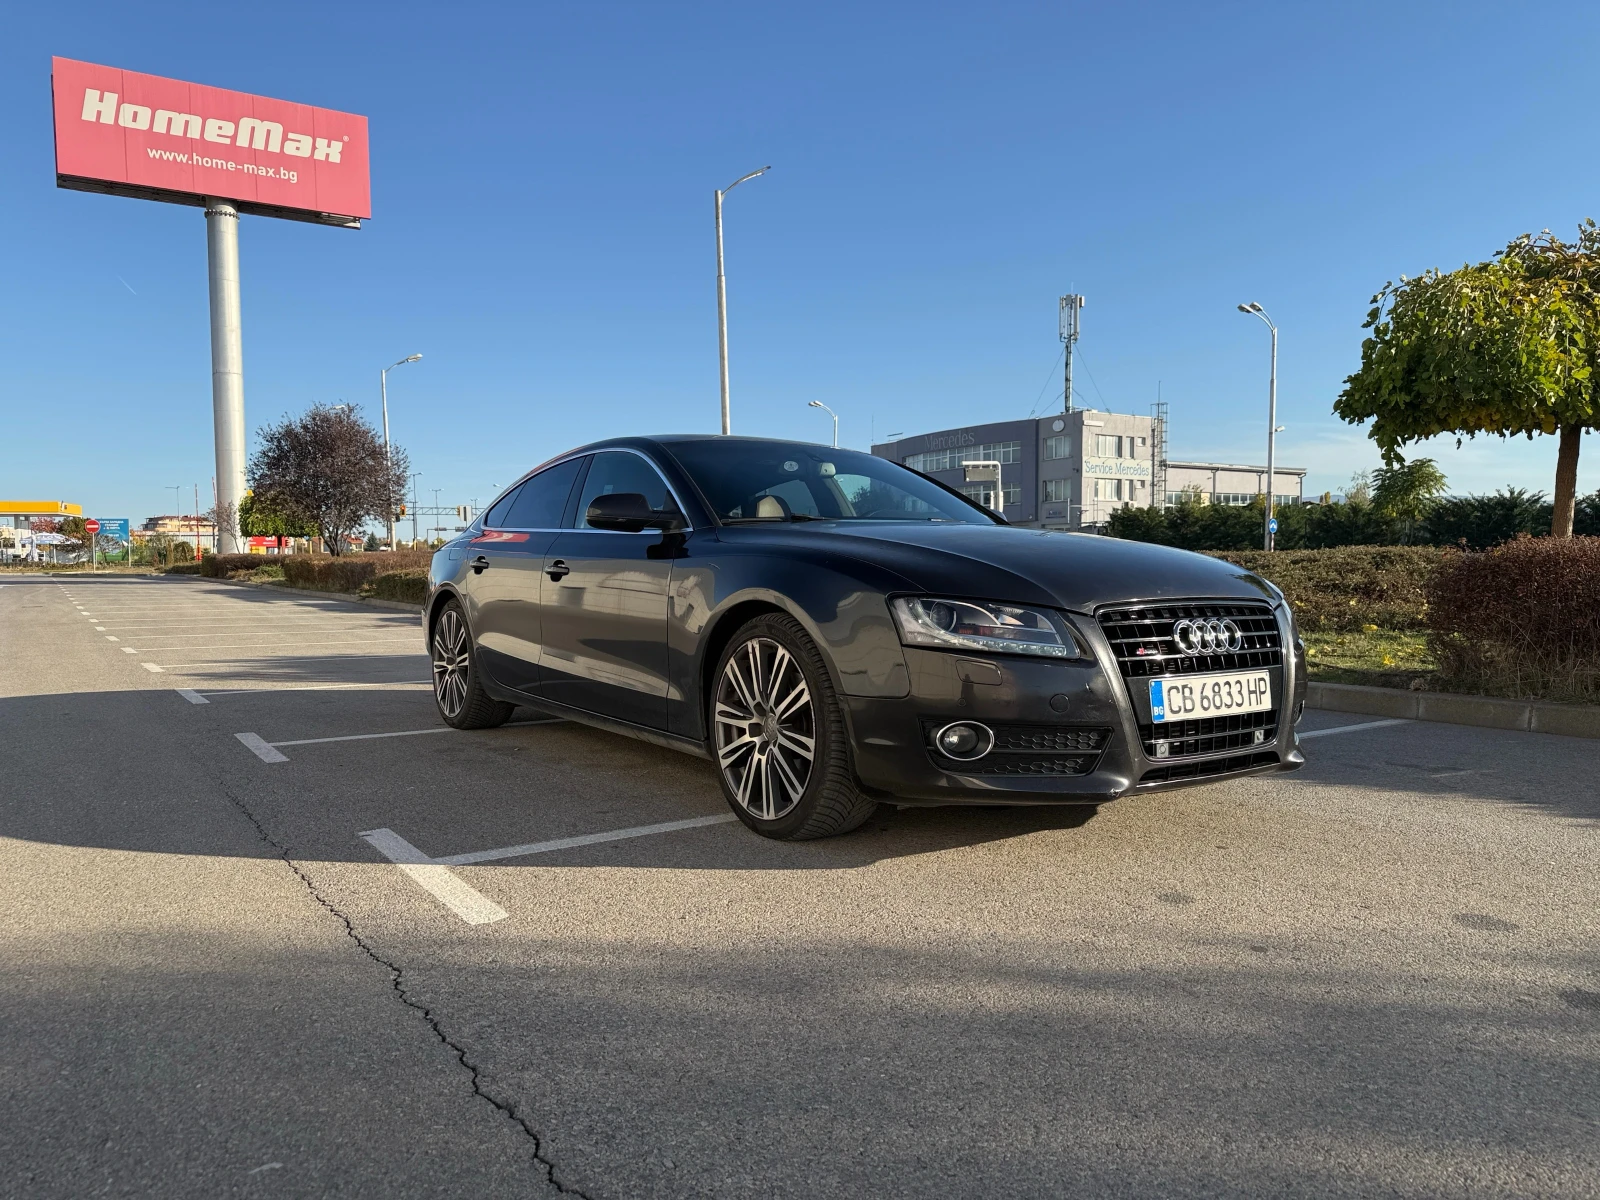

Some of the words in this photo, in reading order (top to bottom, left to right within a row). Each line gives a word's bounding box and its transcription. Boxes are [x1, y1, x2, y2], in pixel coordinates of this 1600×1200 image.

[81, 87, 344, 164] HomeMax
[146, 147, 298, 184] www.home-max.bg
[924, 430, 975, 451] Mercedes
[1085, 460, 1113, 475] Service
[1114, 462, 1150, 477] Mercedes
[1167, 683, 1196, 715] CB
[1200, 679, 1245, 712] 6833
[1247, 676, 1268, 707] HP
[1153, 706, 1164, 716] BG
